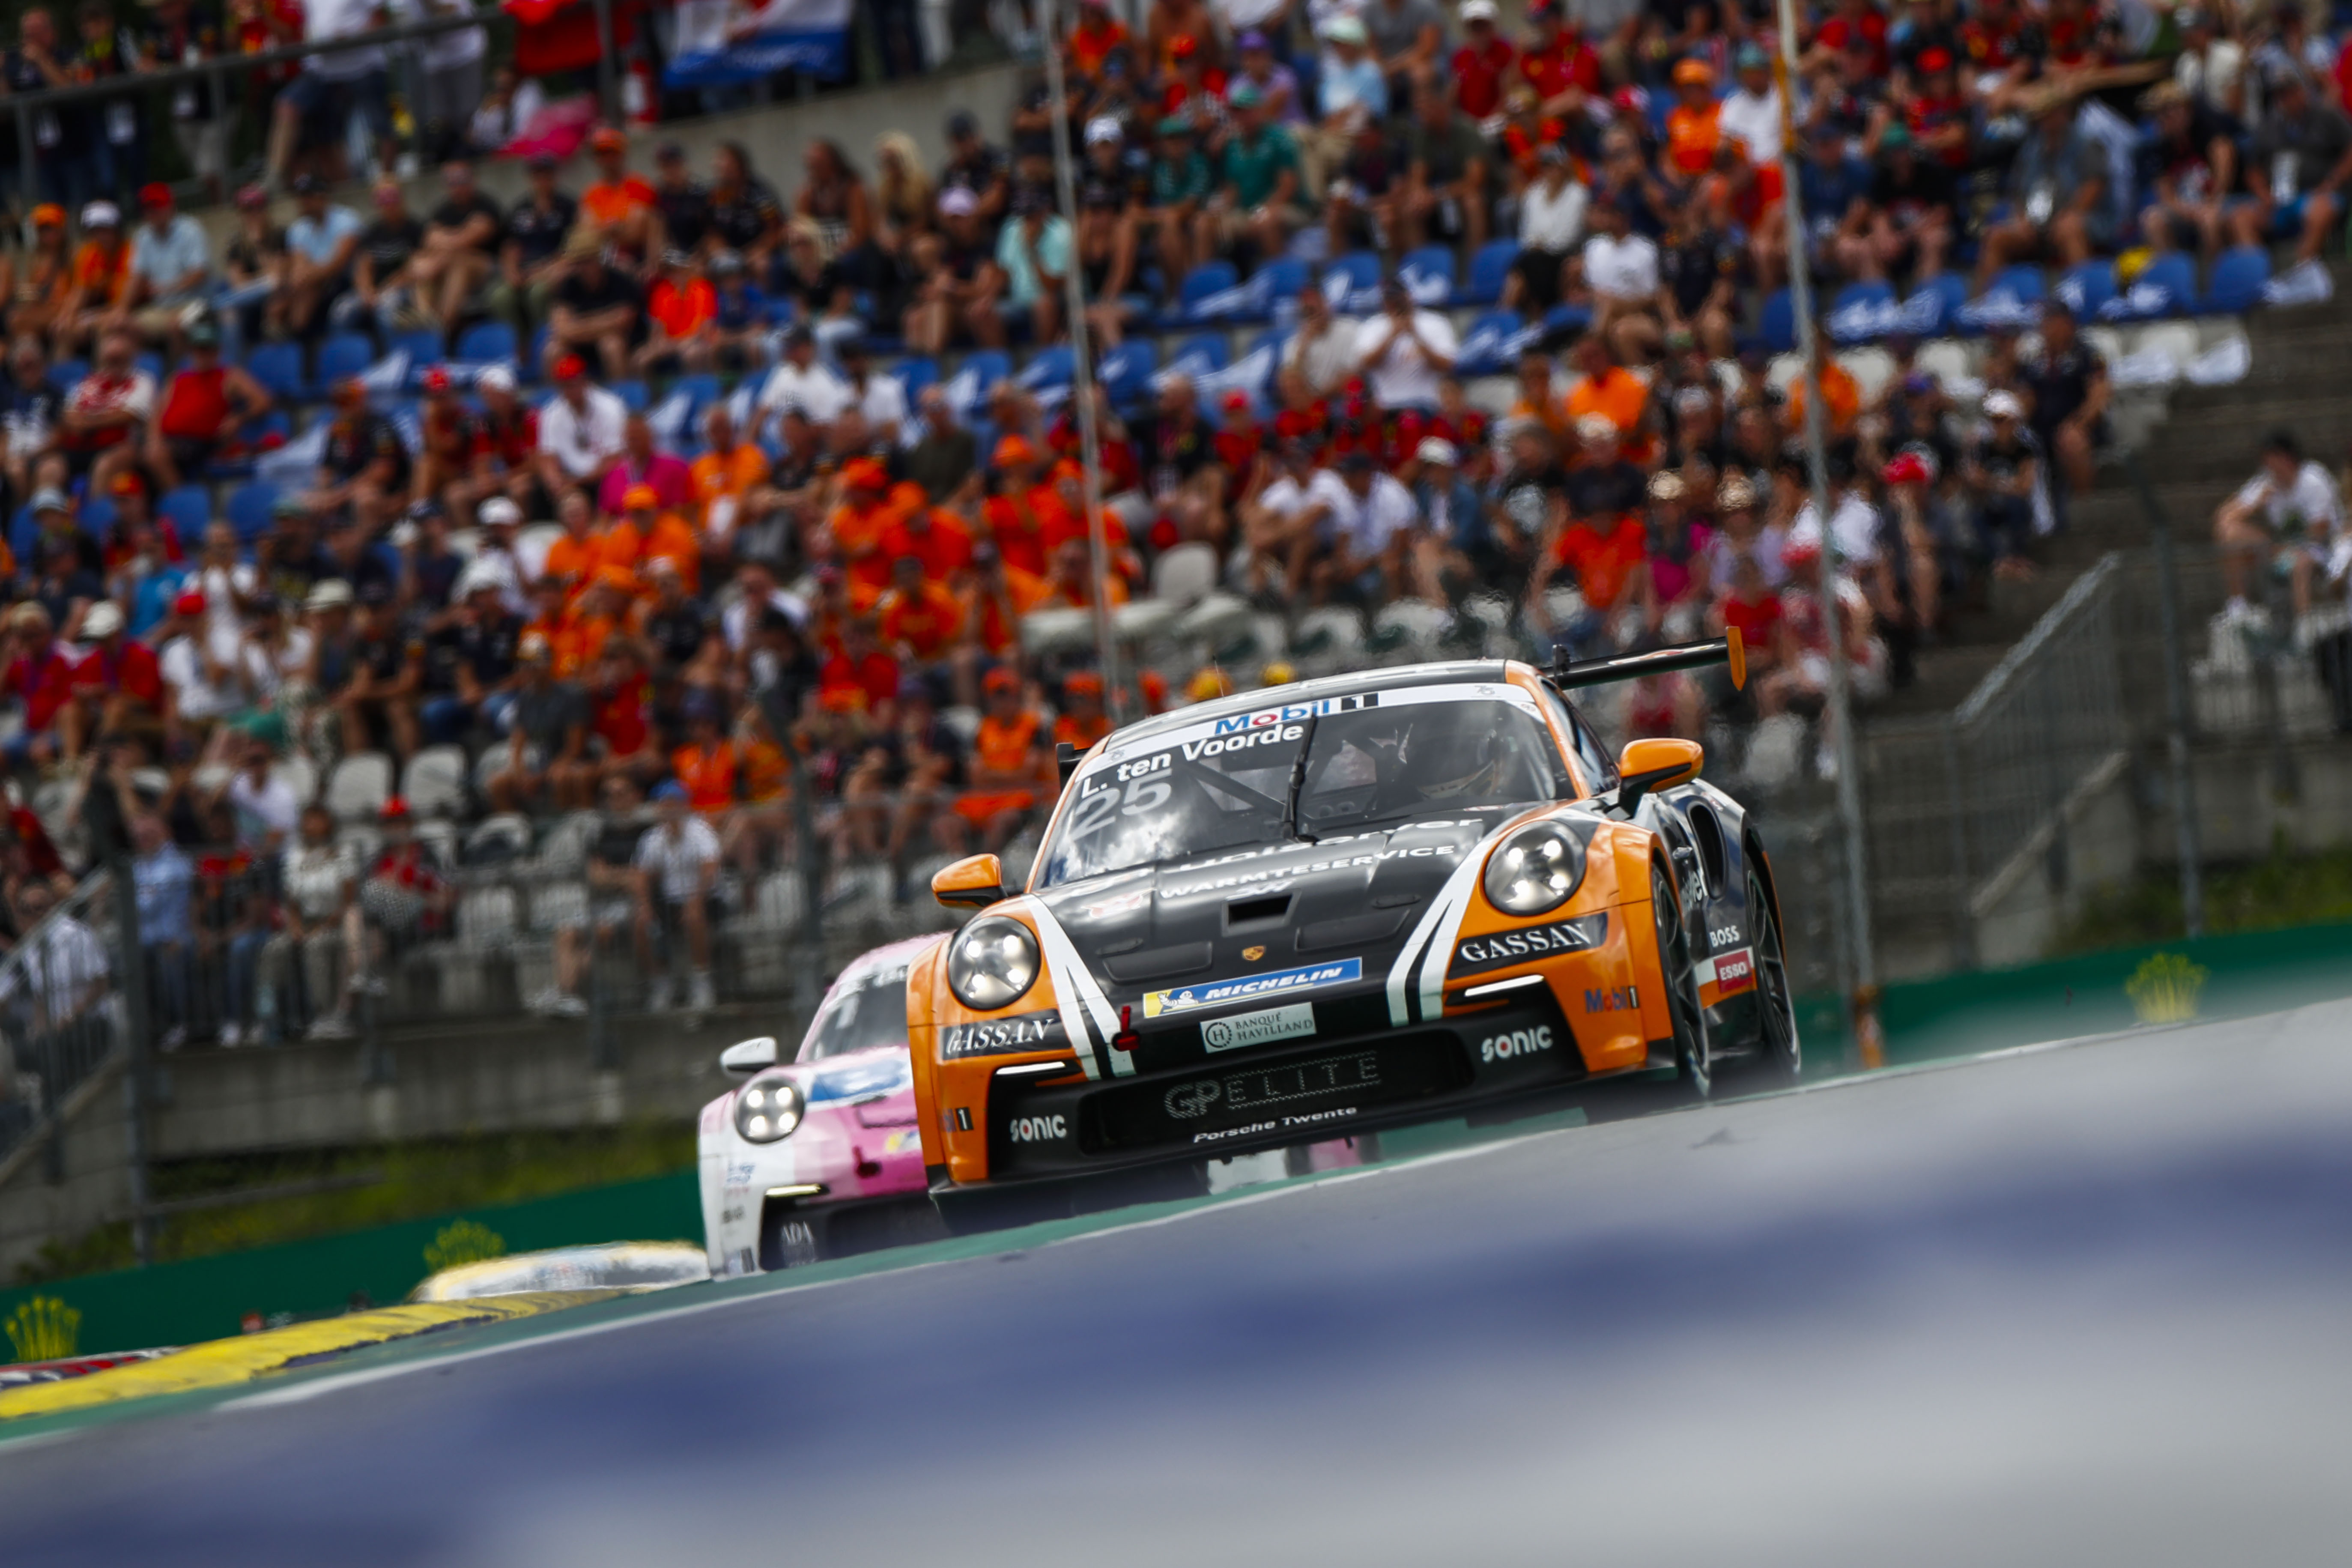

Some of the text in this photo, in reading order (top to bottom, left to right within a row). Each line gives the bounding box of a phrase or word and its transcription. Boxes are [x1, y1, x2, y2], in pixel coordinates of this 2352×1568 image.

[1215, 700, 1330, 735] Mobil
[1081, 777, 1108, 798] L.
[1117, 753, 1172, 782] ten
[1181, 724, 1304, 762] Voorde
[1072, 768, 1173, 842] 25
[1160, 845, 1455, 899] WARMTESERVICE
[1461, 923, 1591, 962] GASSAN
[1710, 925, 1740, 947] BOSS
[1205, 967, 1343, 1000] MICHELIN
[1585, 987, 1627, 1013] Mobil
[946, 1018, 1054, 1055] GASSAN
[1236, 1019, 1313, 1041] HAVILLAND
[1227, 1057, 1379, 1102] ELITE
[1193, 1107, 1357, 1143] Porsche Twente
